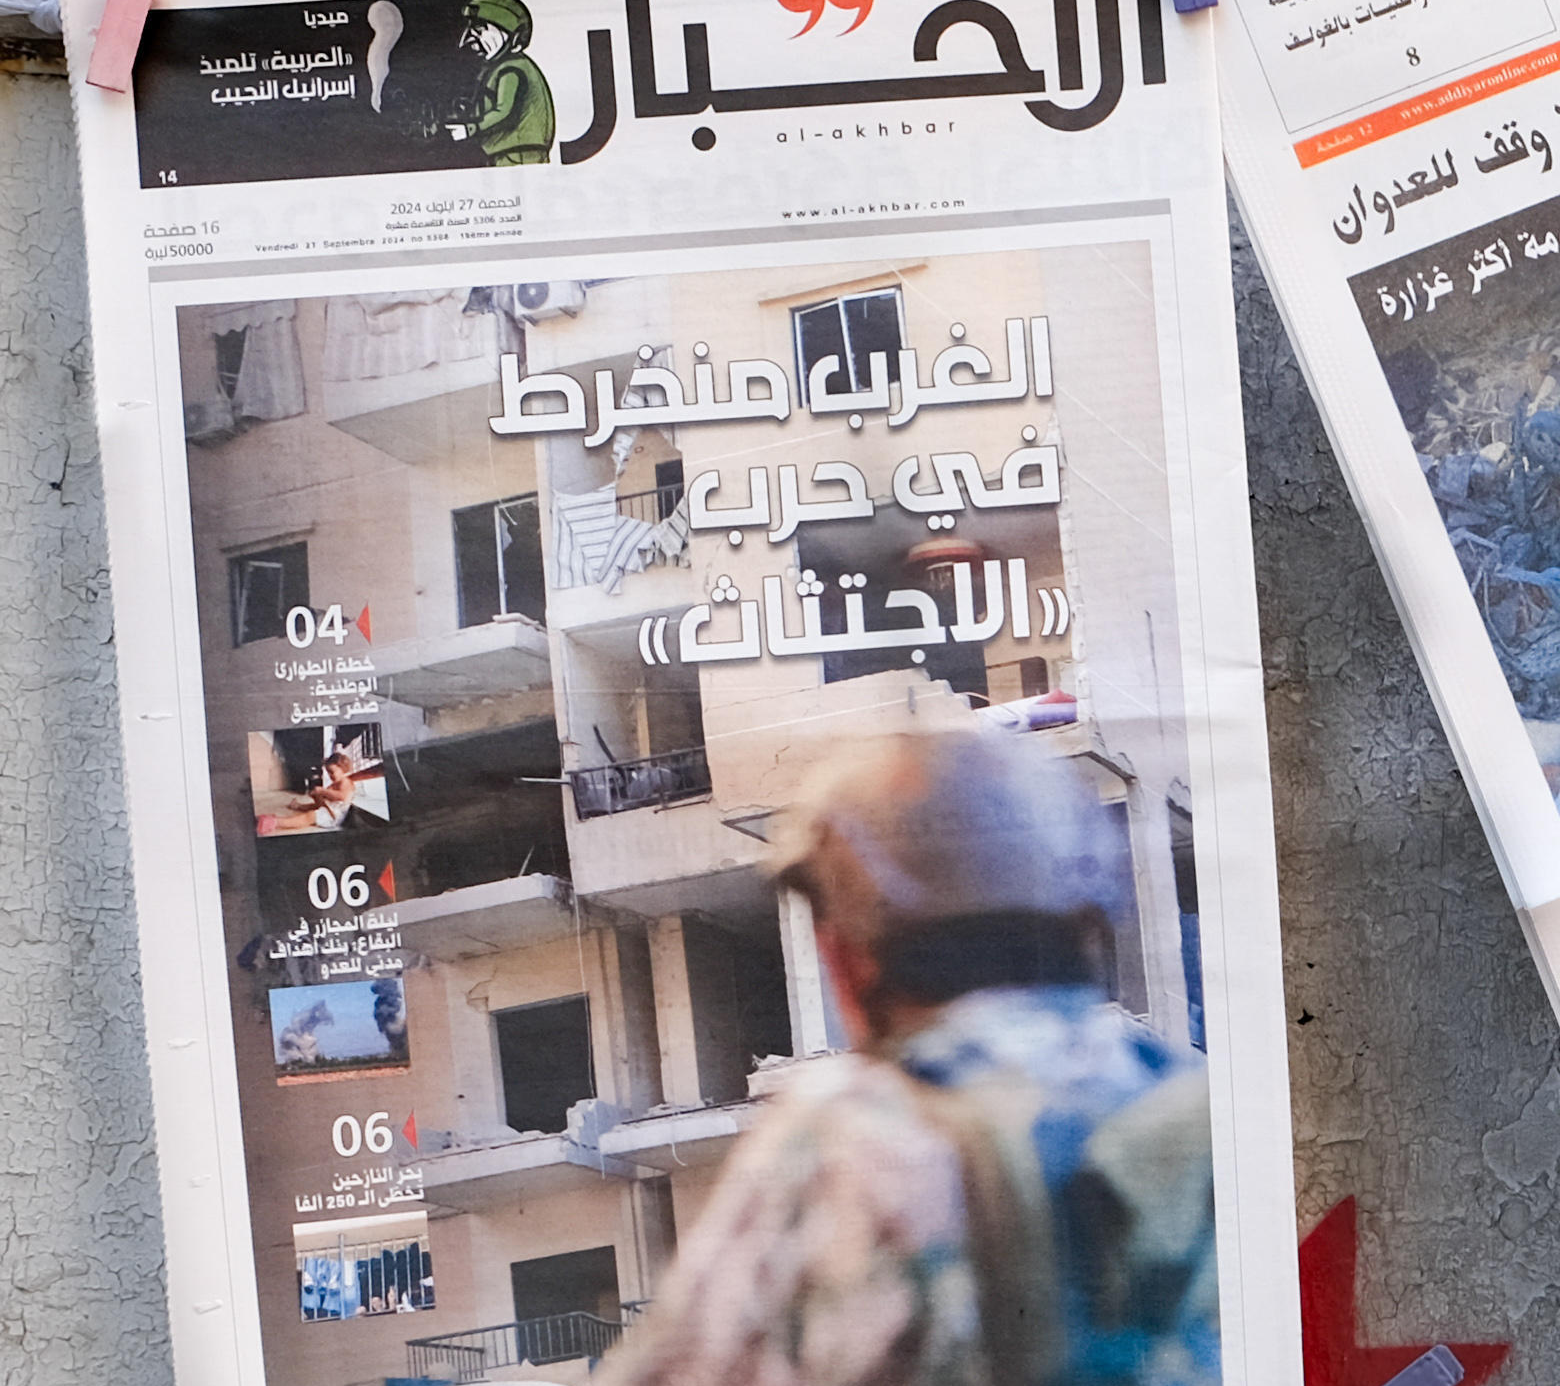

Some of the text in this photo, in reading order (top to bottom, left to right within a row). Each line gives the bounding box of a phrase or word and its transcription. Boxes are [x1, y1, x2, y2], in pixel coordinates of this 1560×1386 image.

[303, 10, 350, 29] ميديا
[1284, 15, 1353, 51] بالغولف
[199, 52, 257, 78] تلميذ
[1405, 46, 1421, 66] 8
[211, 74, 356, 107] إسرائيل النجيب
[1399, 52, 1558, 119] www.addiyaronline.com
[1473, 120, 1553, 174] وقف
[158, 169, 178, 185] 14
[390, 202, 422, 215] 2024
[458, 198, 474, 211] 27
[477, 195, 522, 210] الجمعة
[1332, 147, 1459, 245] للعدوان
[143, 220, 220, 239] 16 صفحة
[1467, 237, 1513, 295] أكثر
[1376, 265, 1454, 321] غزارة
[488, 316, 1054, 449] الغرب منخرط
[687, 425, 1061, 548] في حرب
[286, 604, 348, 648] 04
[336, 655, 375, 673] خطة
[291, 697, 379, 724] صفر تطبيق
[308, 865, 369, 909] 06
[332, 1112, 393, 1157] 06
